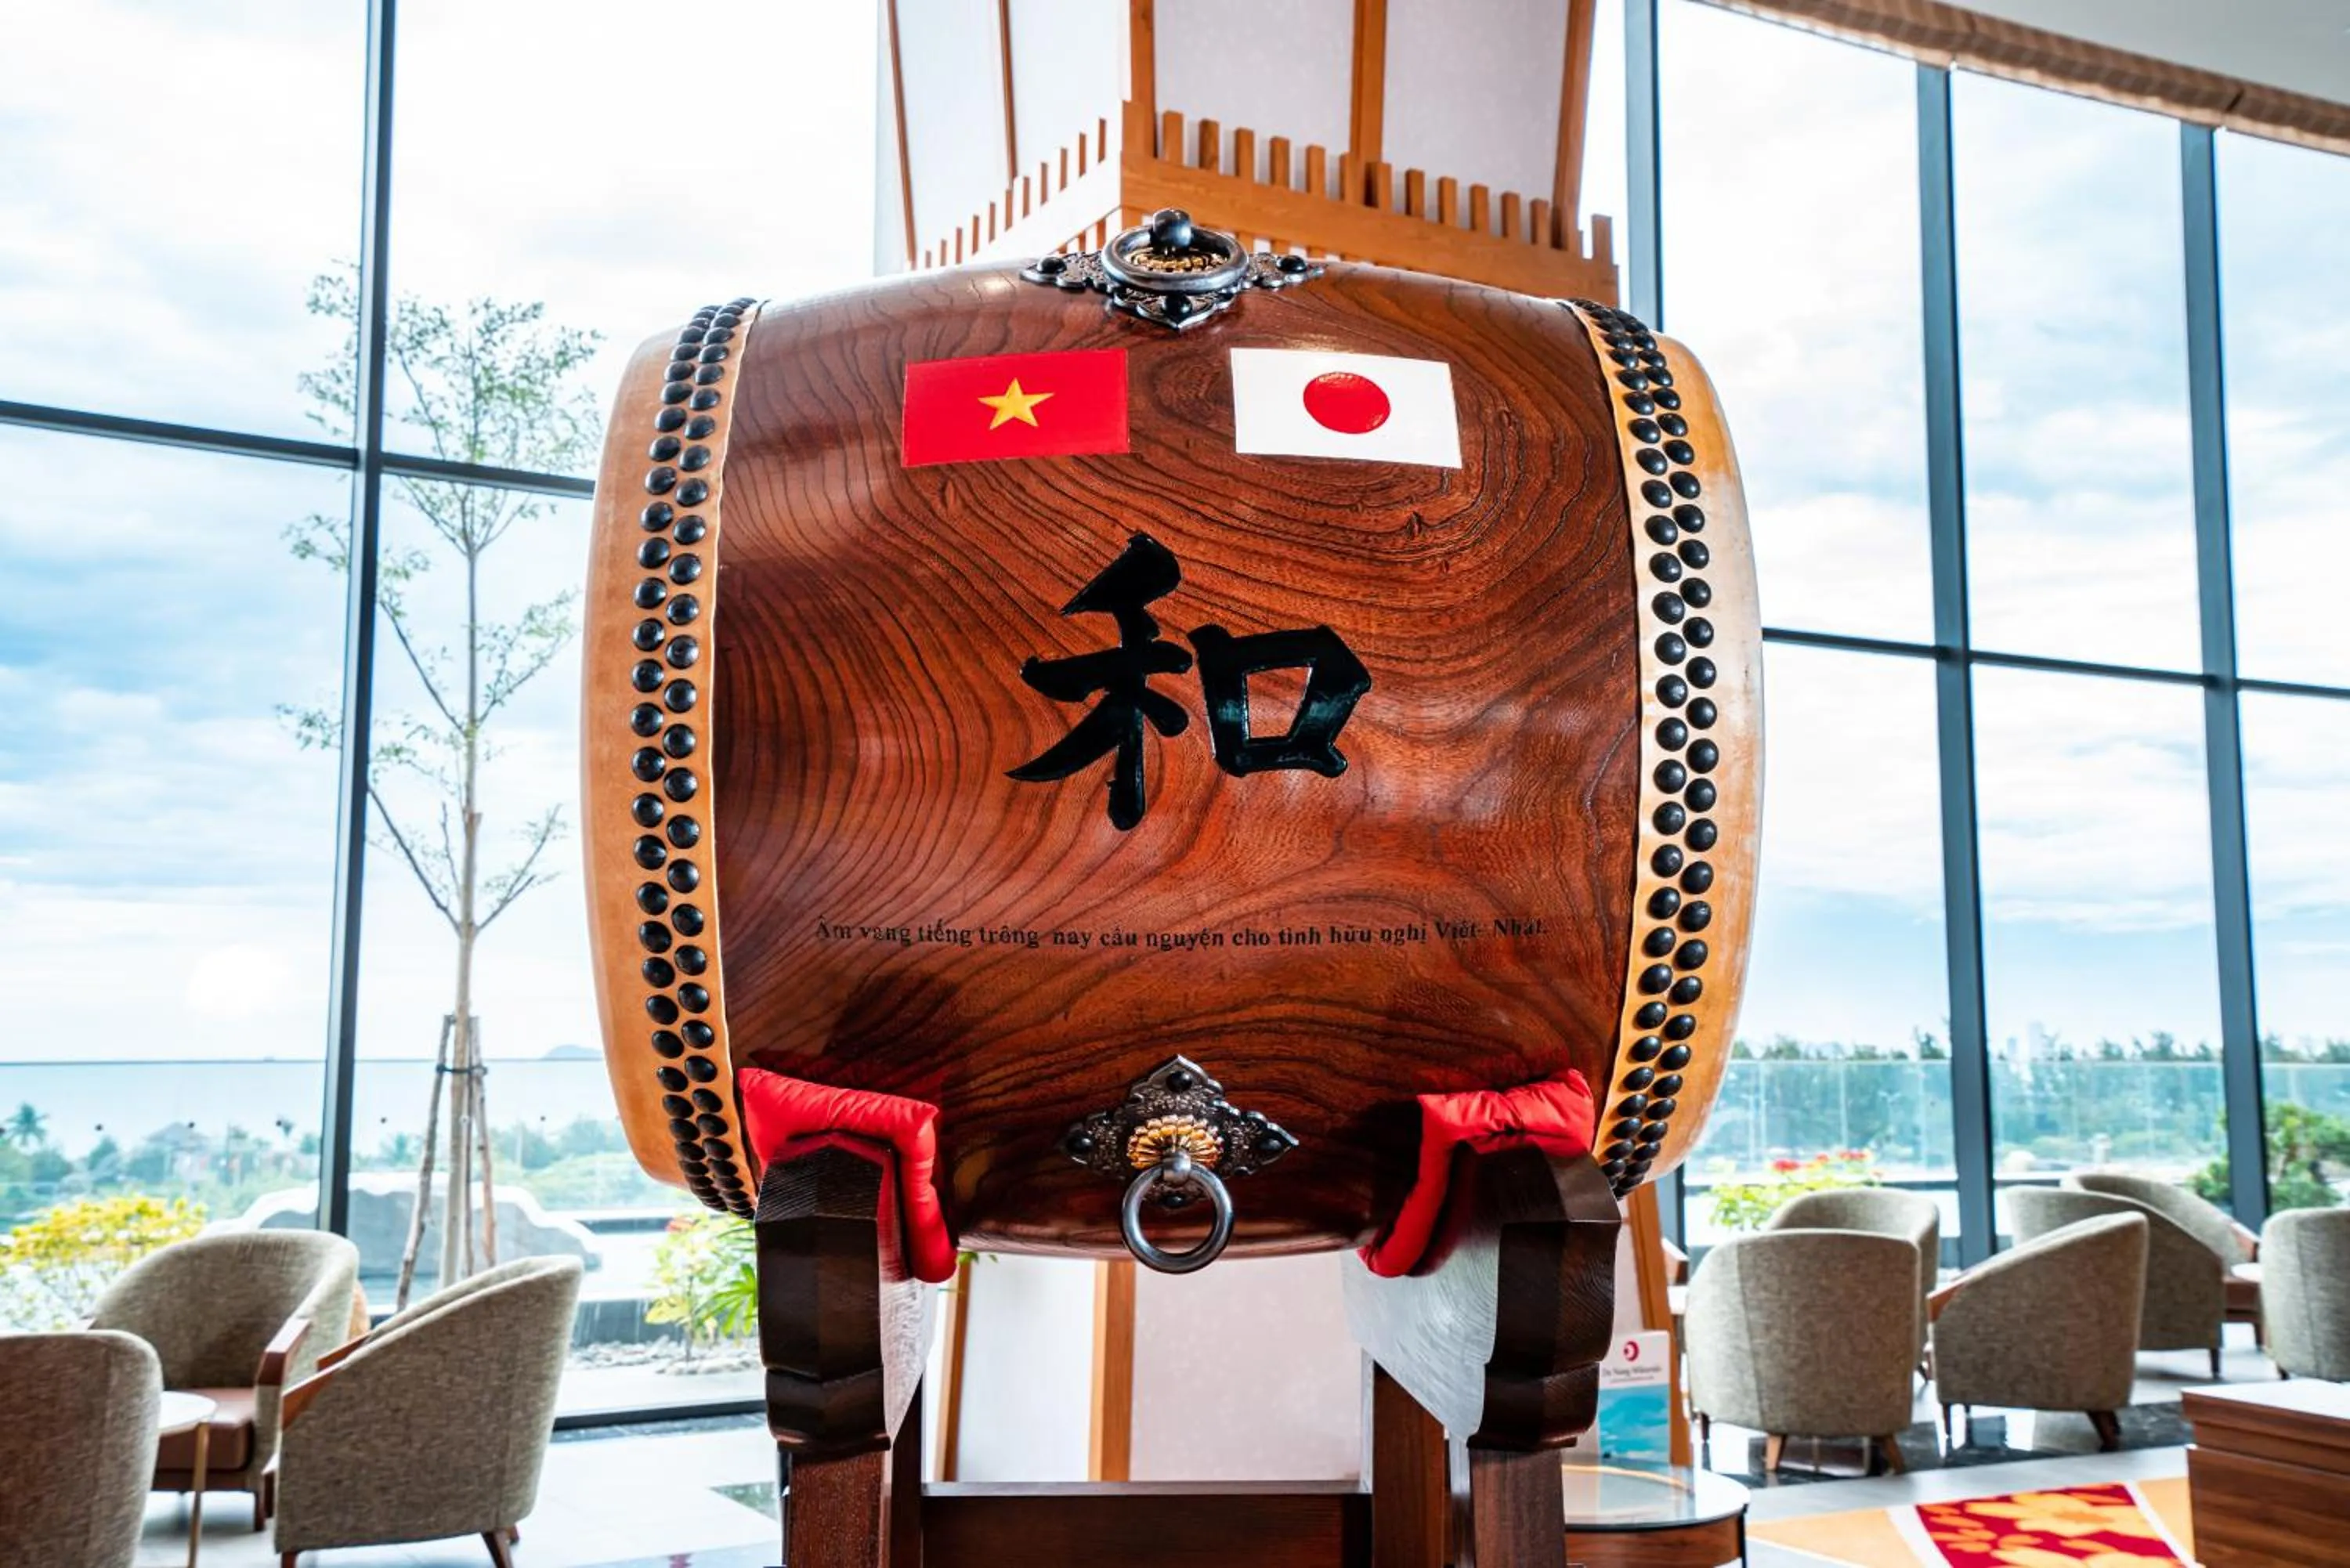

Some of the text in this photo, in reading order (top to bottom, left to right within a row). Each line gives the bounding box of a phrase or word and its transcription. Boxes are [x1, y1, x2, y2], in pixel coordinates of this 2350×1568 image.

[1003, 530, 1372, 831] 和
[859, 927, 912, 947] vang
[918, 919, 973, 948] tiếng
[1232, 927, 1271, 946] cho
